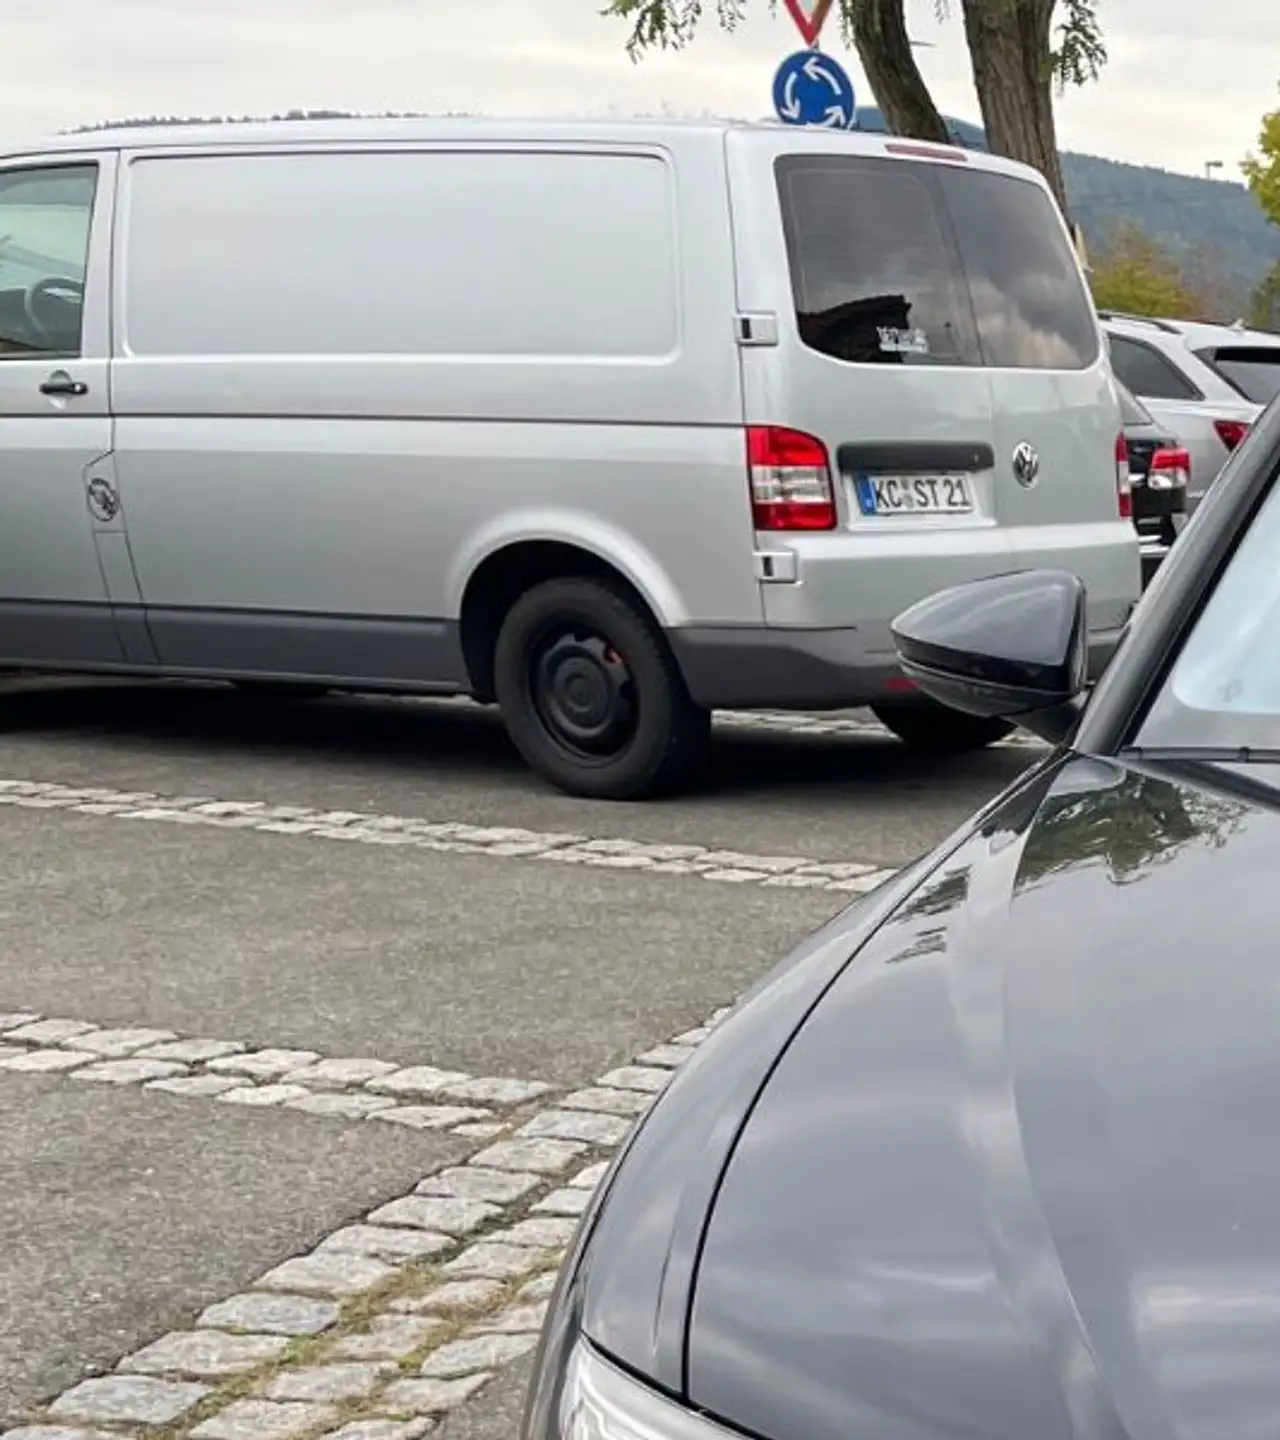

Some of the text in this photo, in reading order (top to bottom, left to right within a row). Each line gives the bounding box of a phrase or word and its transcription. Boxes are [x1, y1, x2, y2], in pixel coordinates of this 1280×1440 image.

[874, 479, 971, 509] KC ST 21
